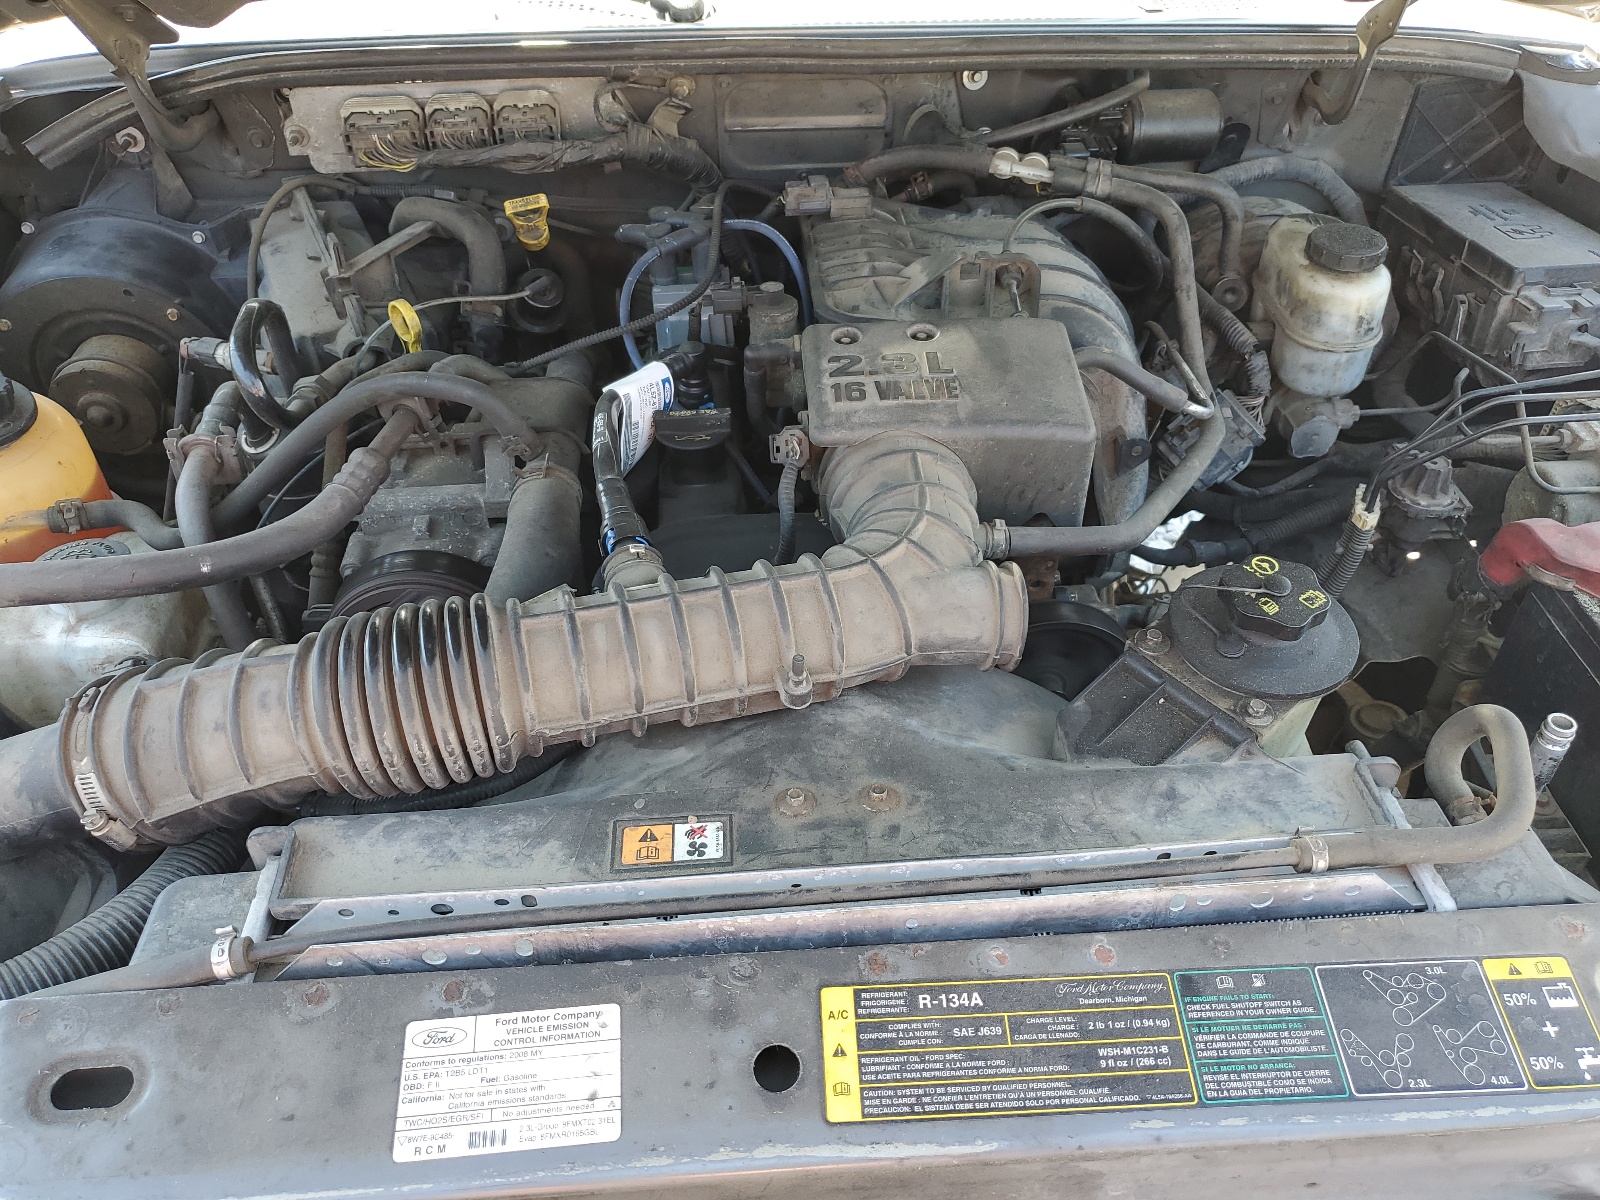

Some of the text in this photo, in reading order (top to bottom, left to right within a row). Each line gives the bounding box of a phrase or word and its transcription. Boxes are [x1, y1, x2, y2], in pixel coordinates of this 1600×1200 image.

[827, 351, 955, 378] 2.3L
[830, 378, 960, 402] 16 VALVE
[1424, 966, 1446, 975] 3.0L
[1054, 980, 1167, 998] Ford Motor Company
[918, 992, 984, 1009] R-134A
[1116, 996, 1148, 1004] Michigan
[1504, 992, 1537, 1006] 50%
[495, 1010, 601, 1026] Ford Motor Company
[828, 1009, 849, 1020] A/C
[506, 1022, 589, 1035] VEHICLE EMISSION
[1088, 1021, 1095, 1029] 2
[1096, 1020, 1105, 1029] lb
[1133, 1019, 1154, 1029] (0.94
[1155, 1018, 1171, 1028] kg)
[953, 1026, 1002, 1036] SAE J639
[422, 1030, 456, 1046] Ford
[494, 1030, 601, 1047] CONTROL INFORMATION
[1098, 1045, 1169, 1057] WSH-M1C231-B
[405, 1060, 445, 1068] Conforms
[458, 1054, 507, 1064] regulations:
[861, 1056, 908, 1064] REFRIGERANT
[1100, 1060, 1106, 1068] 9
[1108, 1058, 1115, 1067] fl
[1136, 1057, 1155, 1068] (266
[1157, 1056, 1172, 1067] cc)
[1530, 1055, 1564, 1070] 50%
[423, 1072, 443, 1080] EPA:
[922, 1069, 978, 1078] REFRIGERANTES
[1241, 1071, 1292, 1080] INTERRUPTOR
[403, 1083, 425, 1091] OBD:
[504, 1073, 538, 1082] Gasoline
[1220, 1080, 1272, 1088] COMBUSTIBLE
[1408, 1079, 1432, 1088] 2.3L
[1490, 1076, 1513, 1085] 4.0L
[402, 1094, 445, 1105] California:
[530, 1084, 546, 1093] with
[448, 1097, 527, 1110] California emissions
[516, 1106, 562, 1117] adjustments
[566, 1102, 595, 1111] needed
[414, 1144, 446, 1156] R C M
